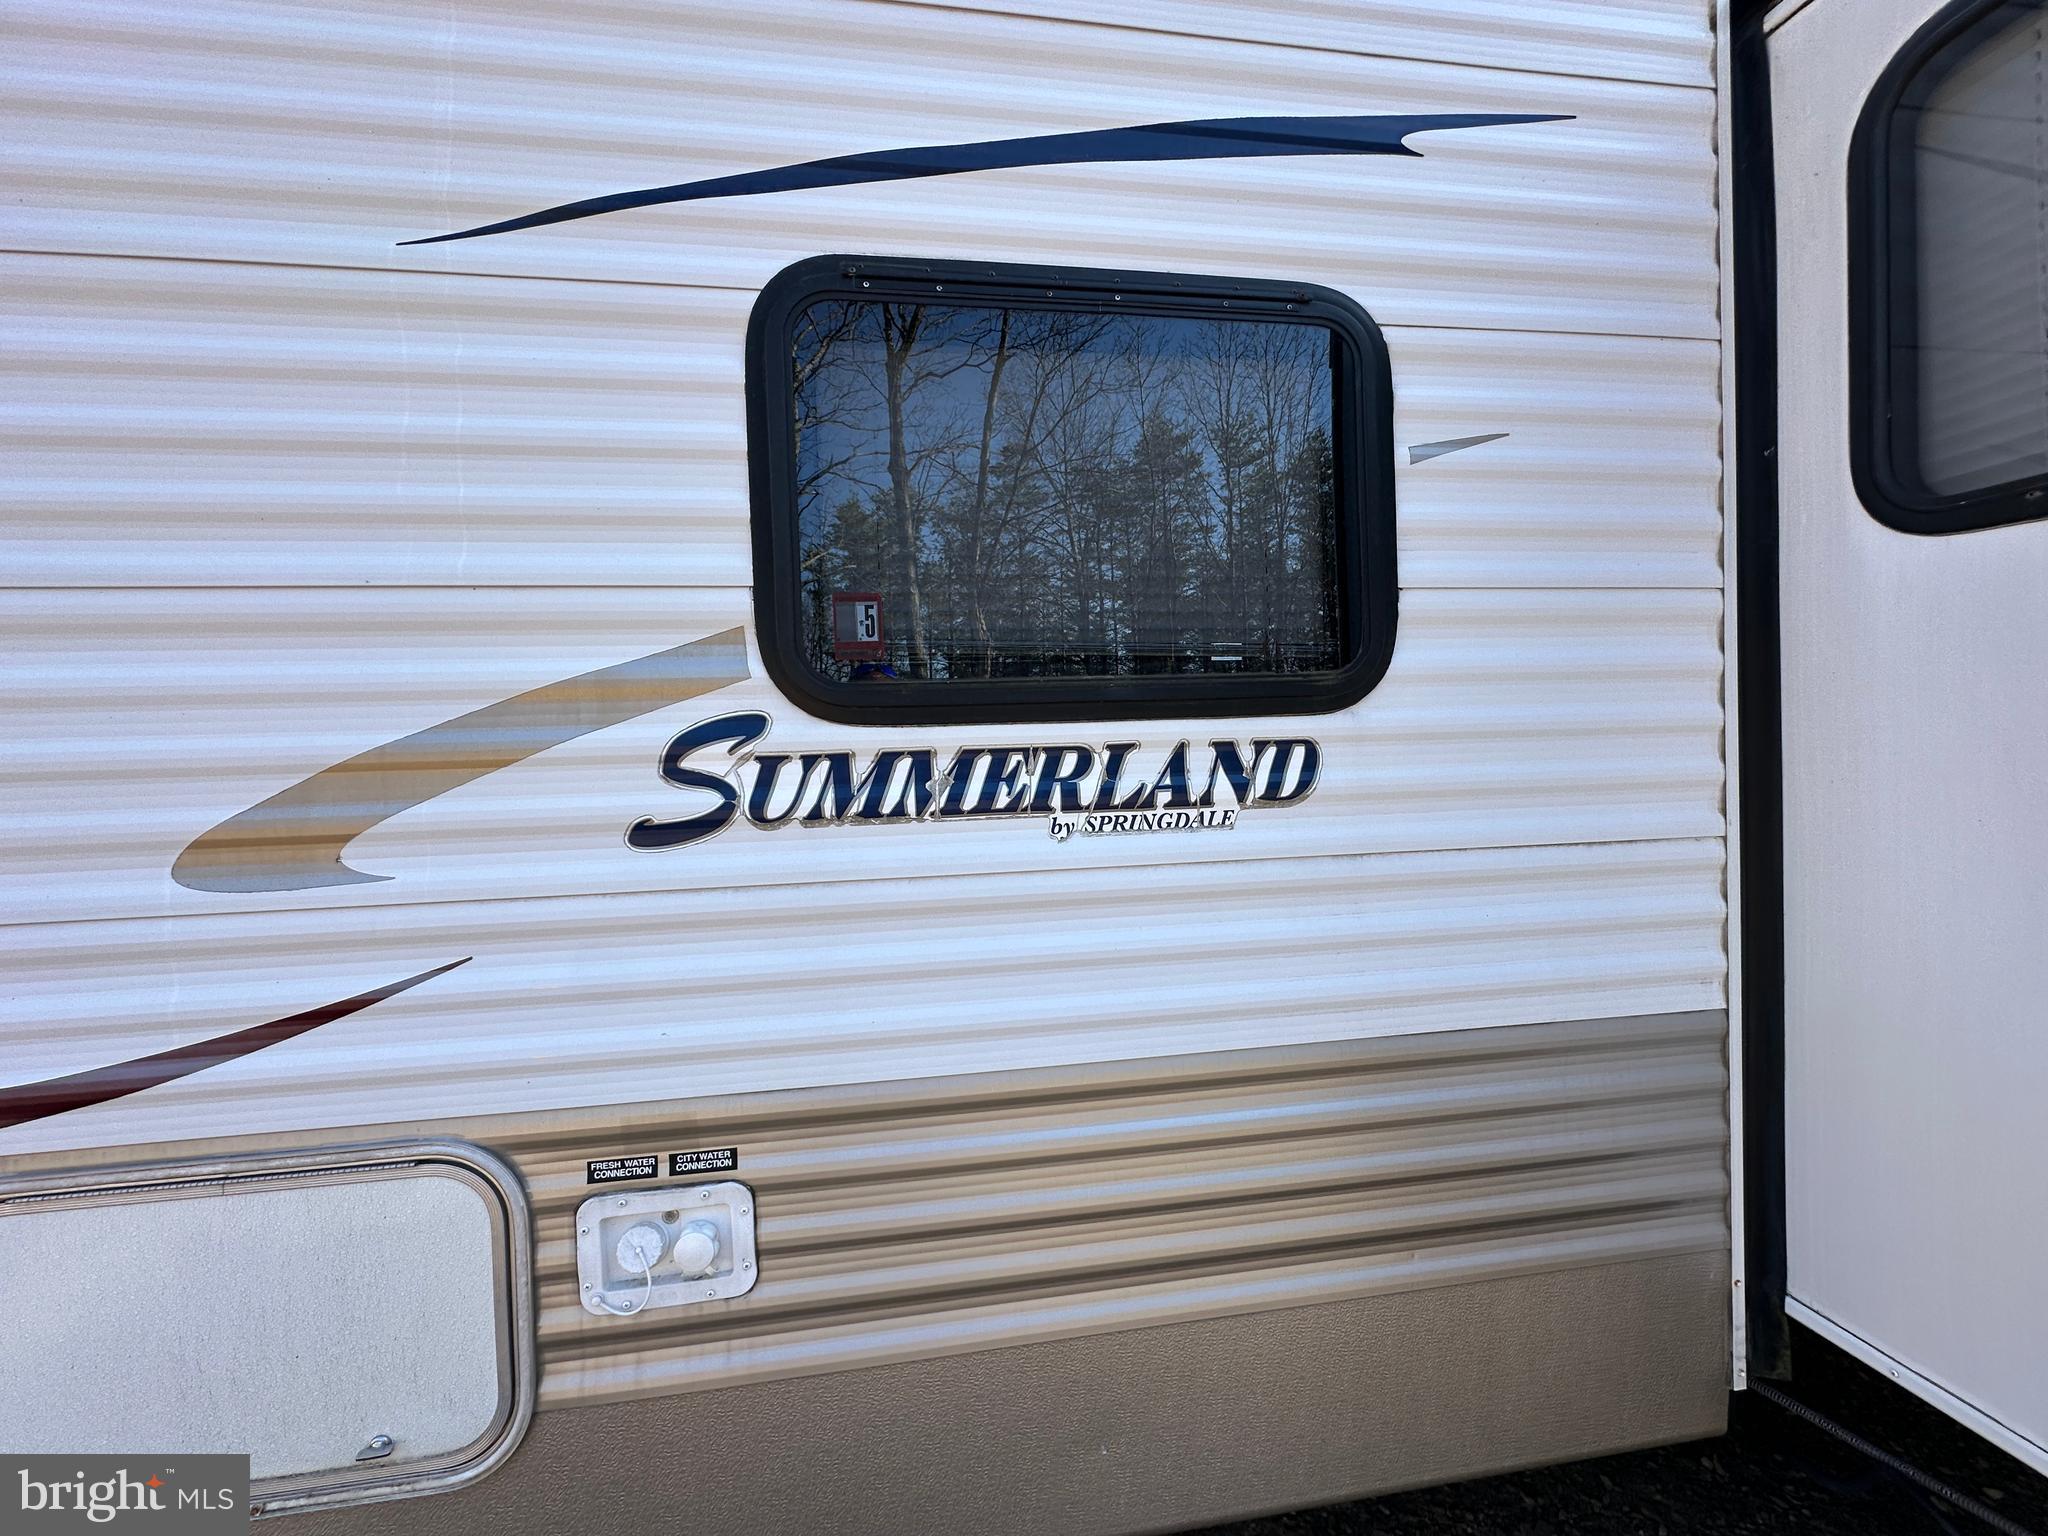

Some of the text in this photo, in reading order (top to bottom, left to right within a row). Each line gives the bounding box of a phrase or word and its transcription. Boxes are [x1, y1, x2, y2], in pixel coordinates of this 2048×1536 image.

[626, 711, 1322, 852] SUMMERLAND
[1050, 809, 1235, 840] by SPRINGDALE
[677, 1151, 731, 1163] CITY WATER
[591, 1158, 655, 1170] FRESH WATER
[676, 1159, 732, 1172] CONNECTION
[594, 1167, 652, 1179] CONNECTION
